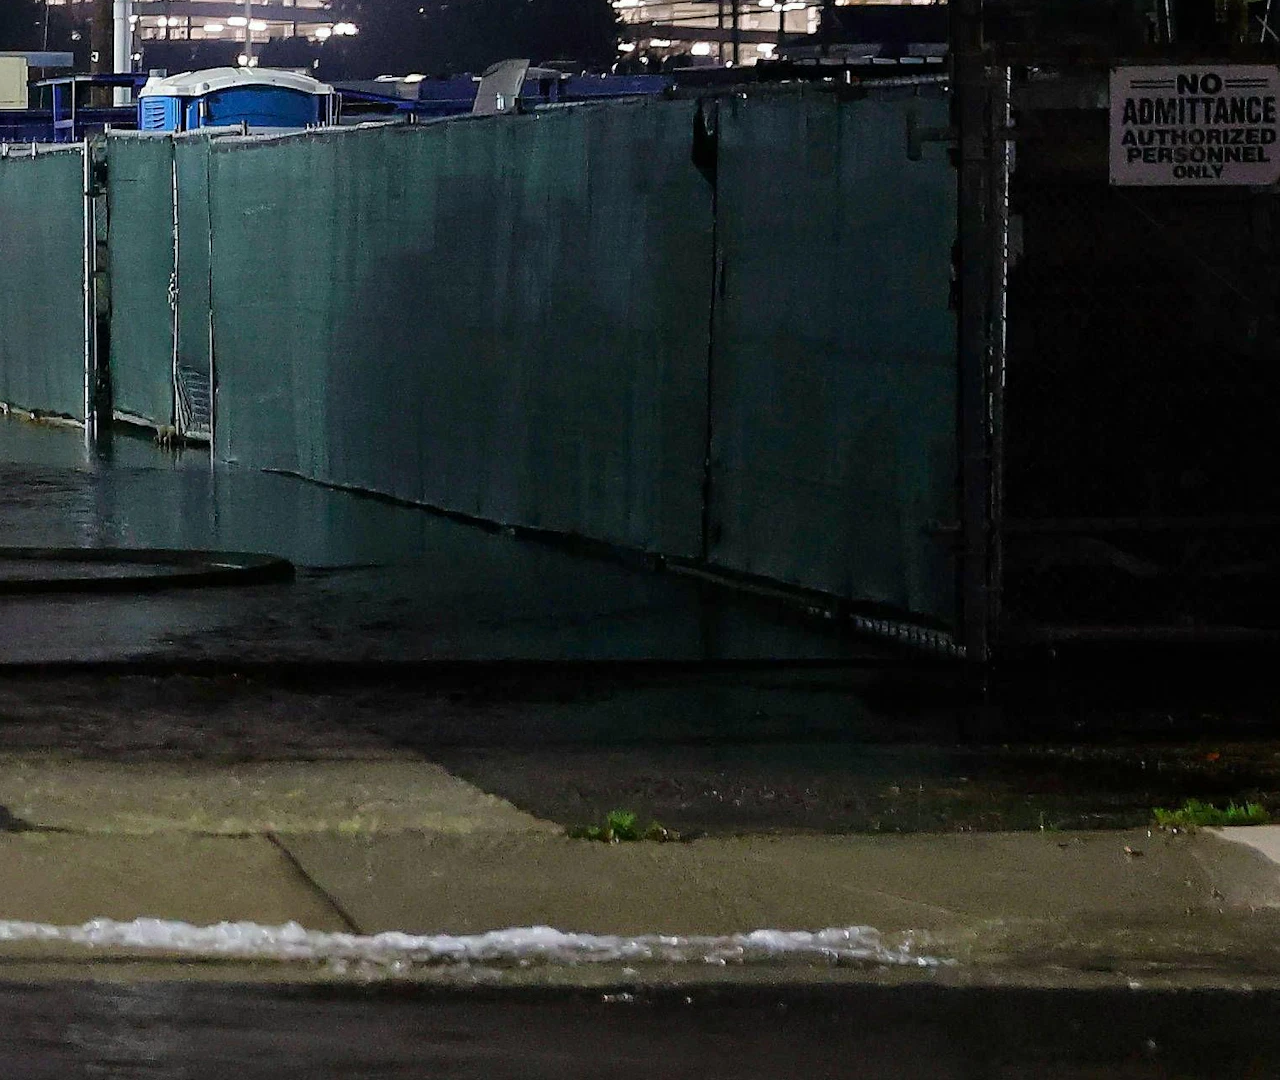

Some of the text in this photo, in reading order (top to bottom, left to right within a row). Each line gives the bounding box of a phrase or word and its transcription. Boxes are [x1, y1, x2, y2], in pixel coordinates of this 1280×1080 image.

[1176, 73, 1223, 95] NO
[1122, 96, 1277, 125] ADMITTANCE
[1121, 128, 1277, 146] AUTHORIZED
[1127, 146, 1271, 164] PERSONNEL
[1173, 165, 1224, 179] ONLY
